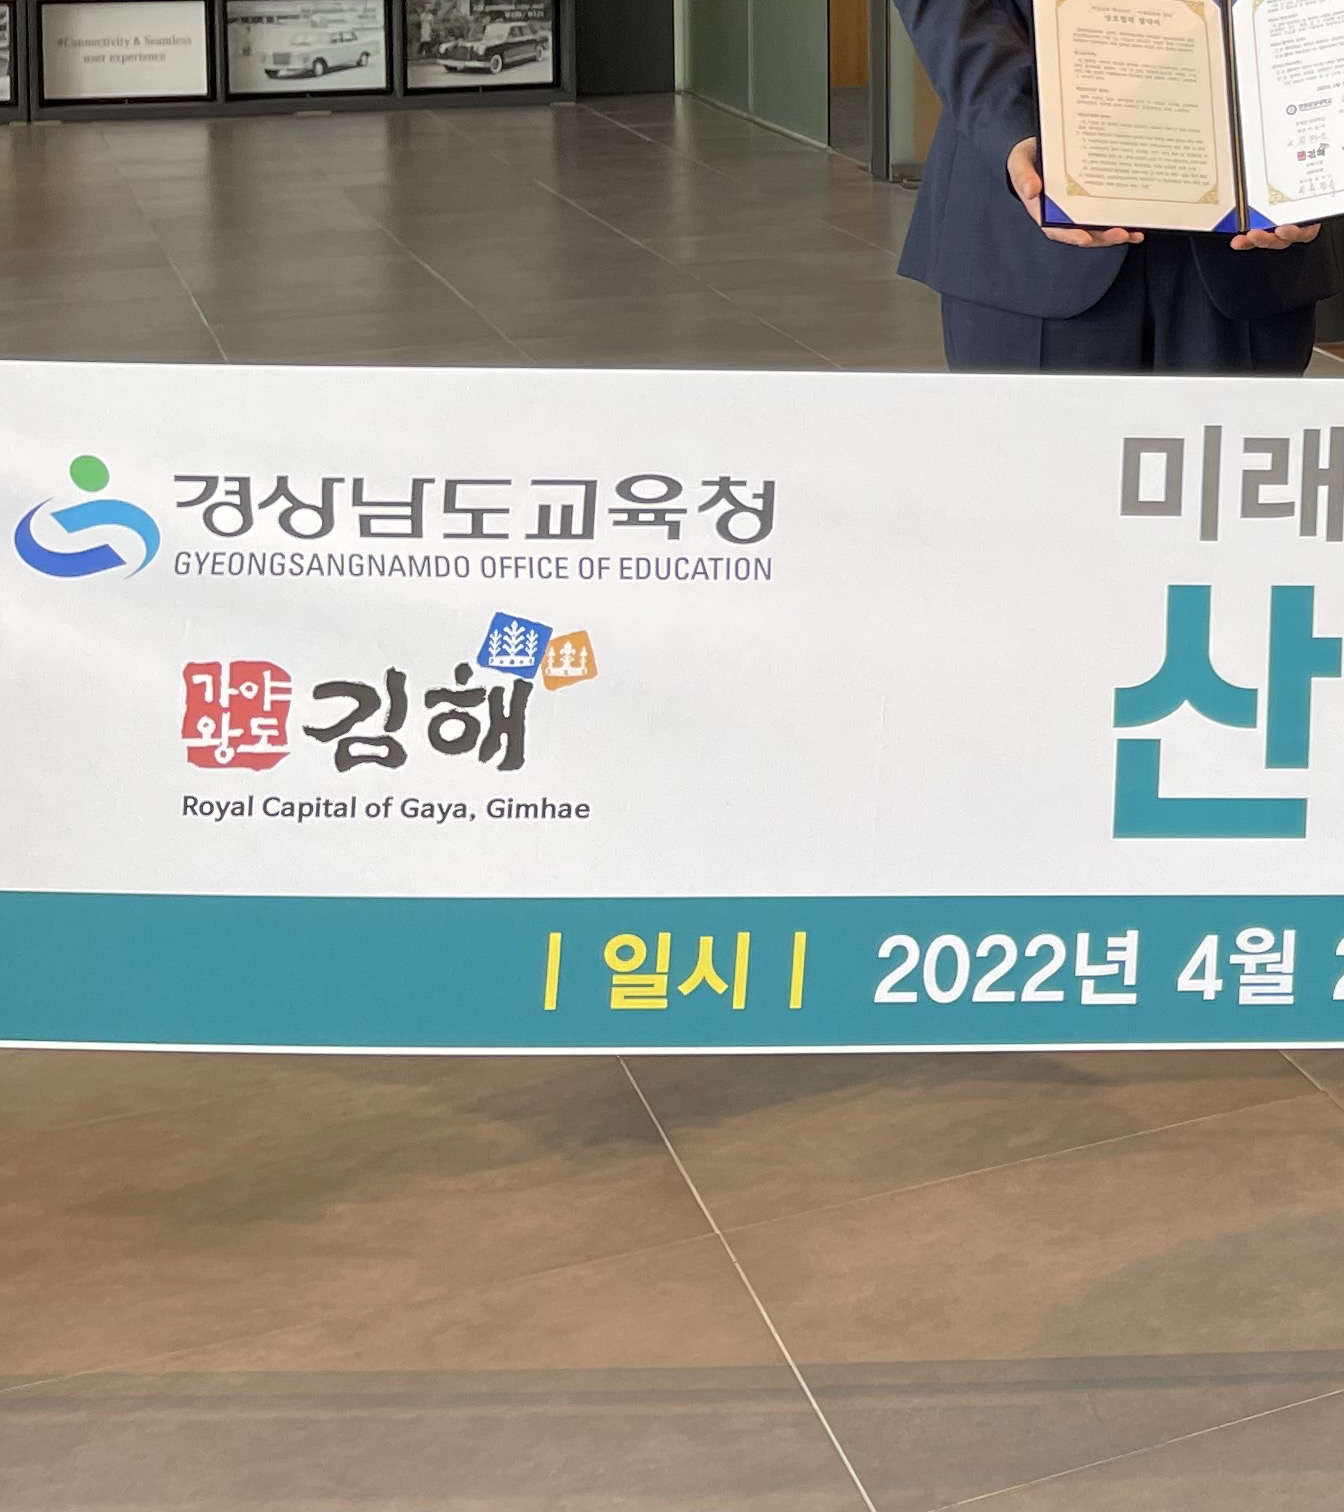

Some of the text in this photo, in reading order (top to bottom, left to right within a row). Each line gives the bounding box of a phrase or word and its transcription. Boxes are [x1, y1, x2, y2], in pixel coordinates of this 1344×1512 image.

[174, 474, 777, 546] 경상남도교육청
[174, 551, 774, 582] GYEONGSANGNAMDO OFFICE OF EDUCATION
[302, 662, 534, 774] 김해
[183, 796, 592, 826] Royal Capital of Gaya, Gimhae
[604, 933, 751, 1011] 일시
[874, 931, 1142, 1007] 2022년
[1176, 928, 1299, 1007] 4월
